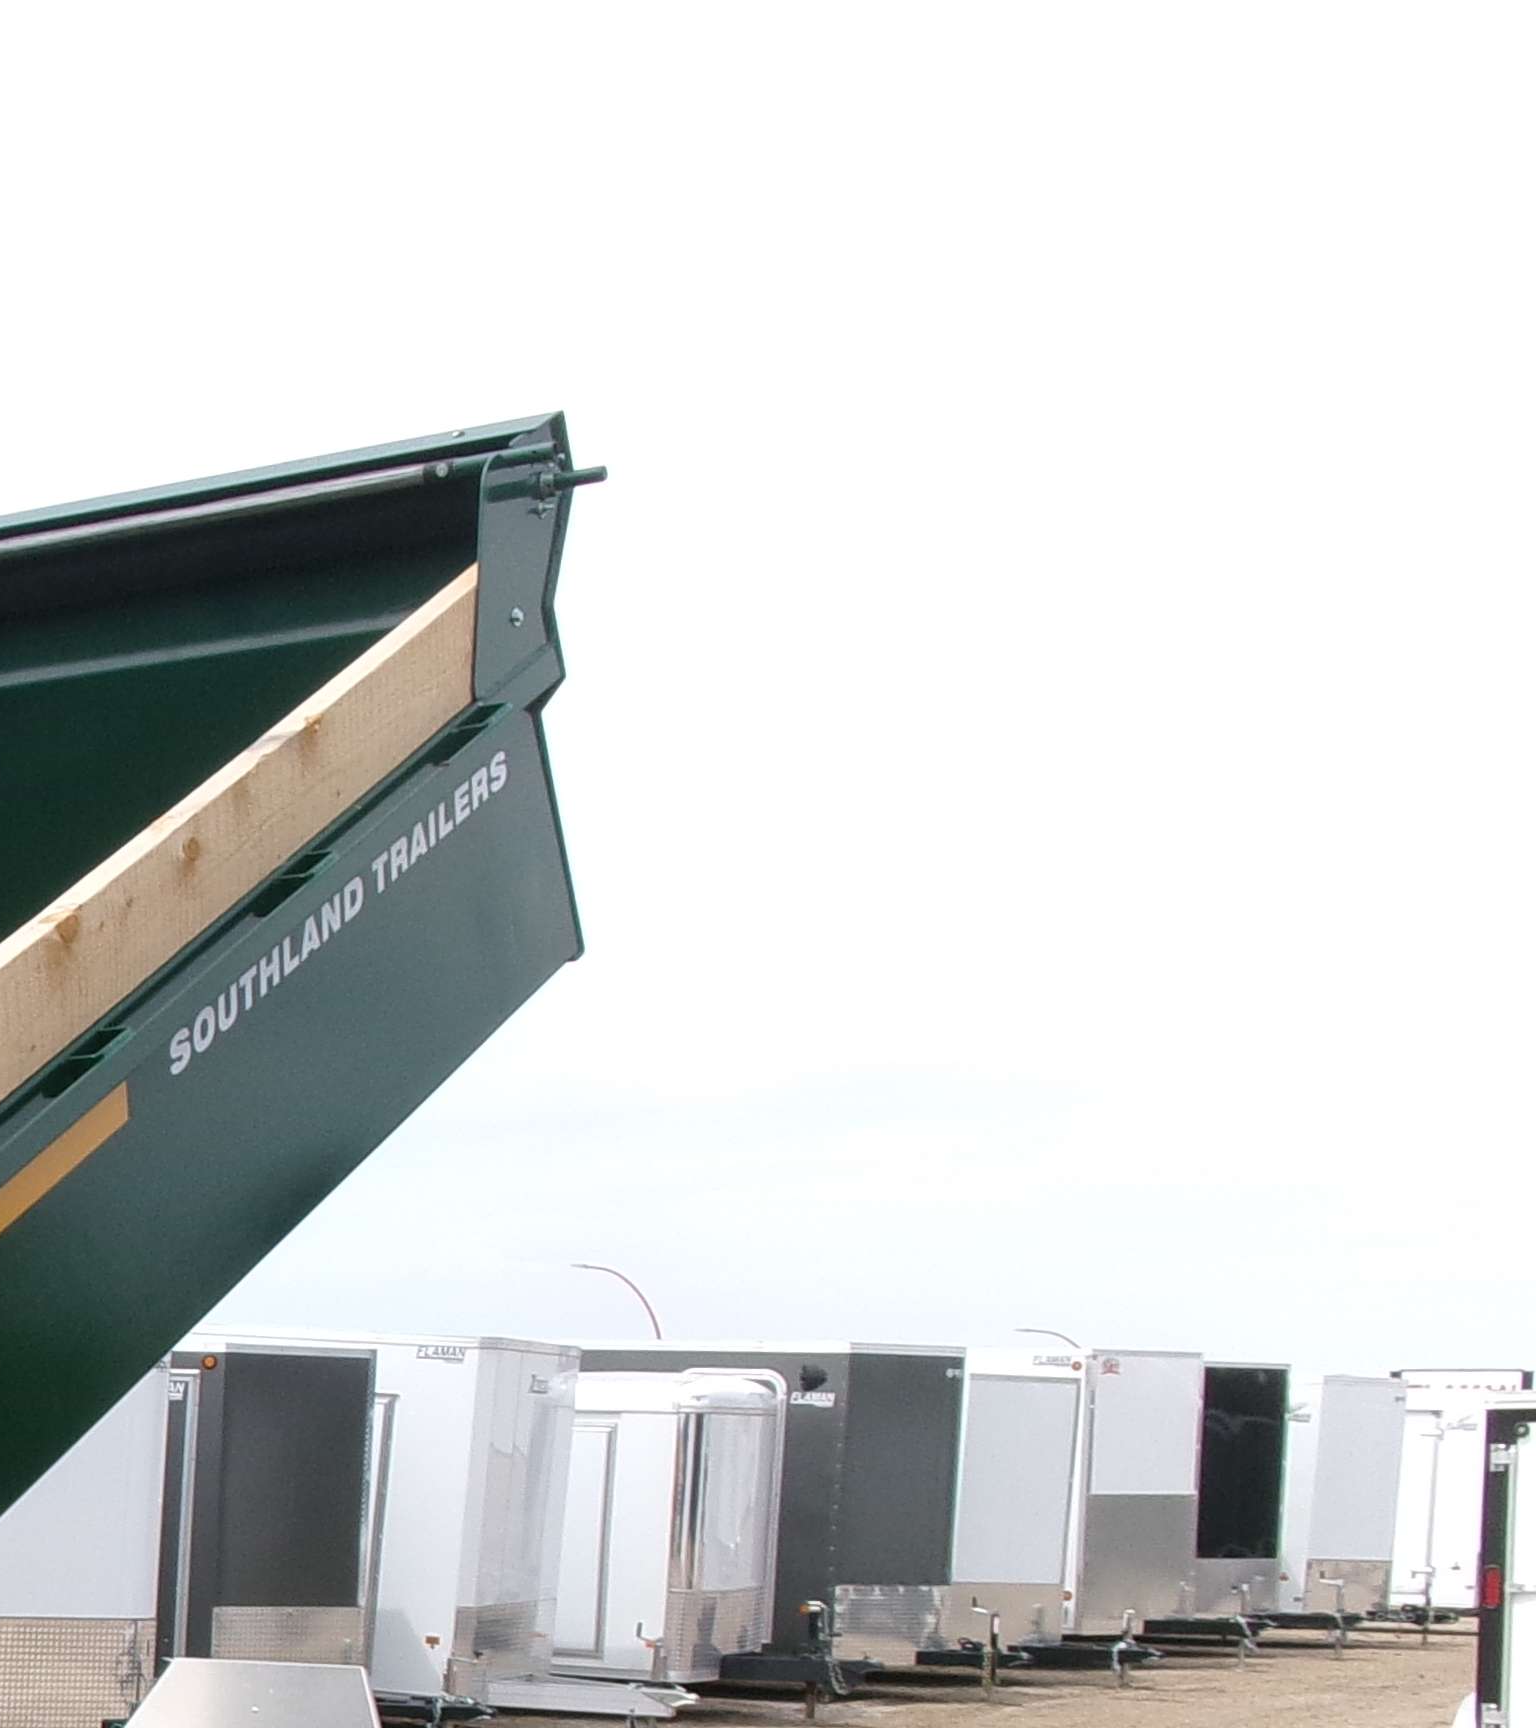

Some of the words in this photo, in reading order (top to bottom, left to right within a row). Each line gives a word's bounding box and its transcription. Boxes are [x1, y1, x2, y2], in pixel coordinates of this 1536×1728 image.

[169, 876, 364, 1076] SOUTHLAND
[372, 750, 509, 894] TRAILERS
[416, 1345, 465, 1360] FLAMAN
